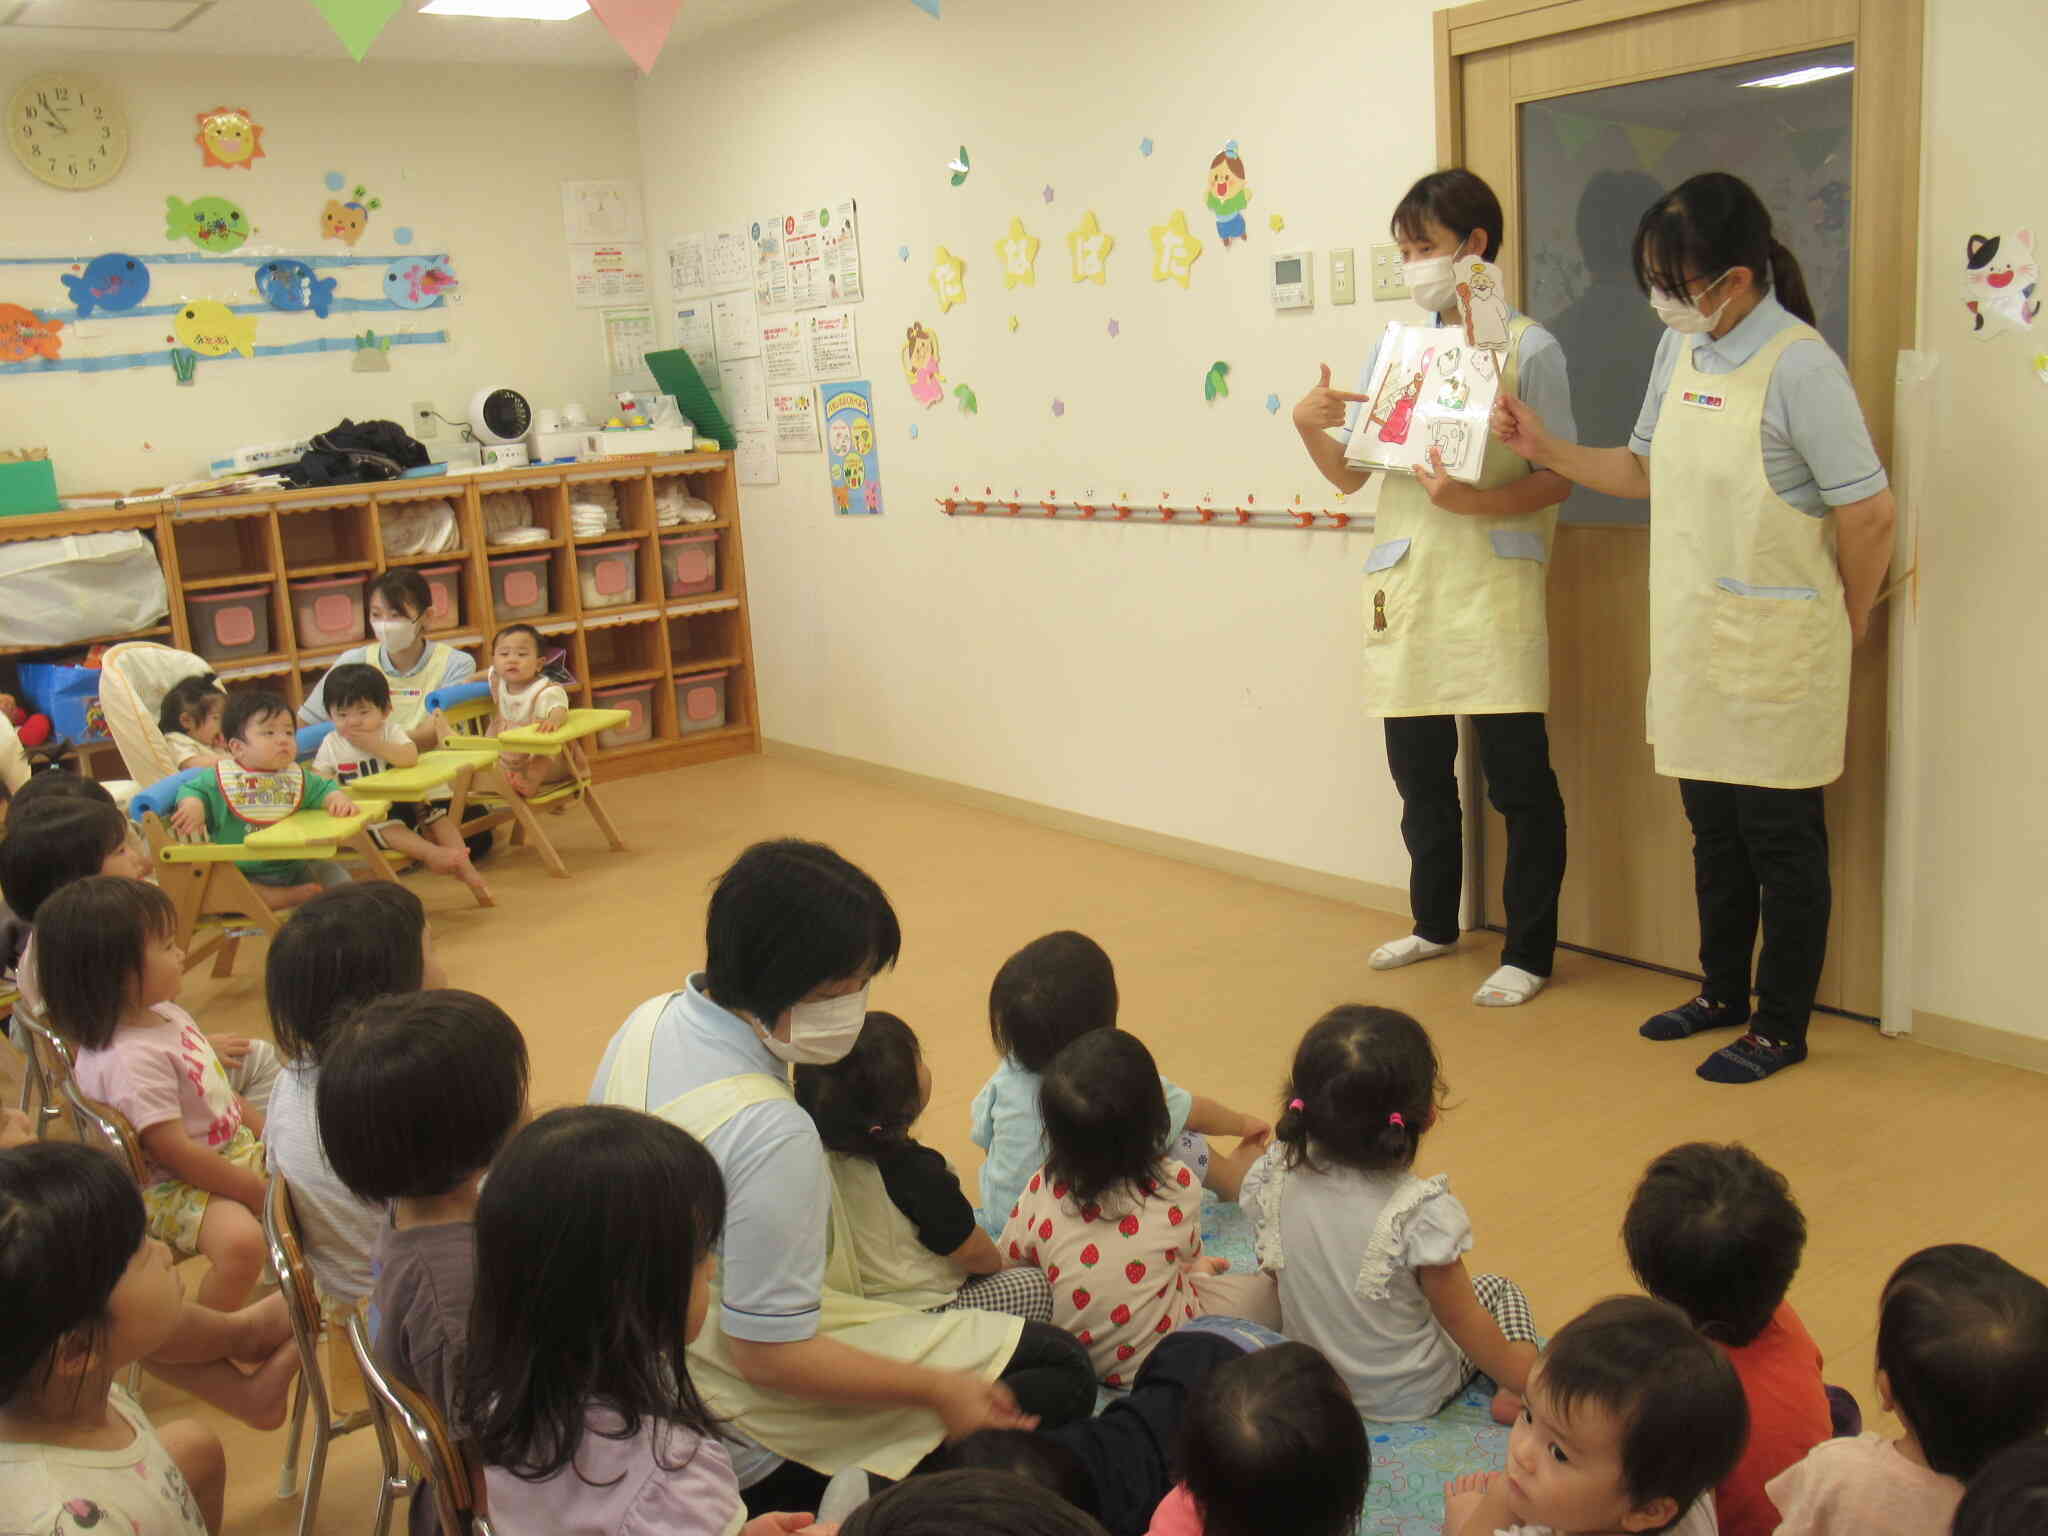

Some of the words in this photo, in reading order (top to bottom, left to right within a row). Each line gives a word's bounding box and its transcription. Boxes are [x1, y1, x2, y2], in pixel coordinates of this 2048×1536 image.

[55, 87, 69, 101] 12
[25, 104, 38, 120] 10
[93, 105, 104, 120] 2
[32, 143, 41, 157] 8
[97, 143, 107, 157] 4
[68, 161, 78, 176] 6
[88, 157, 97, 172] 5
